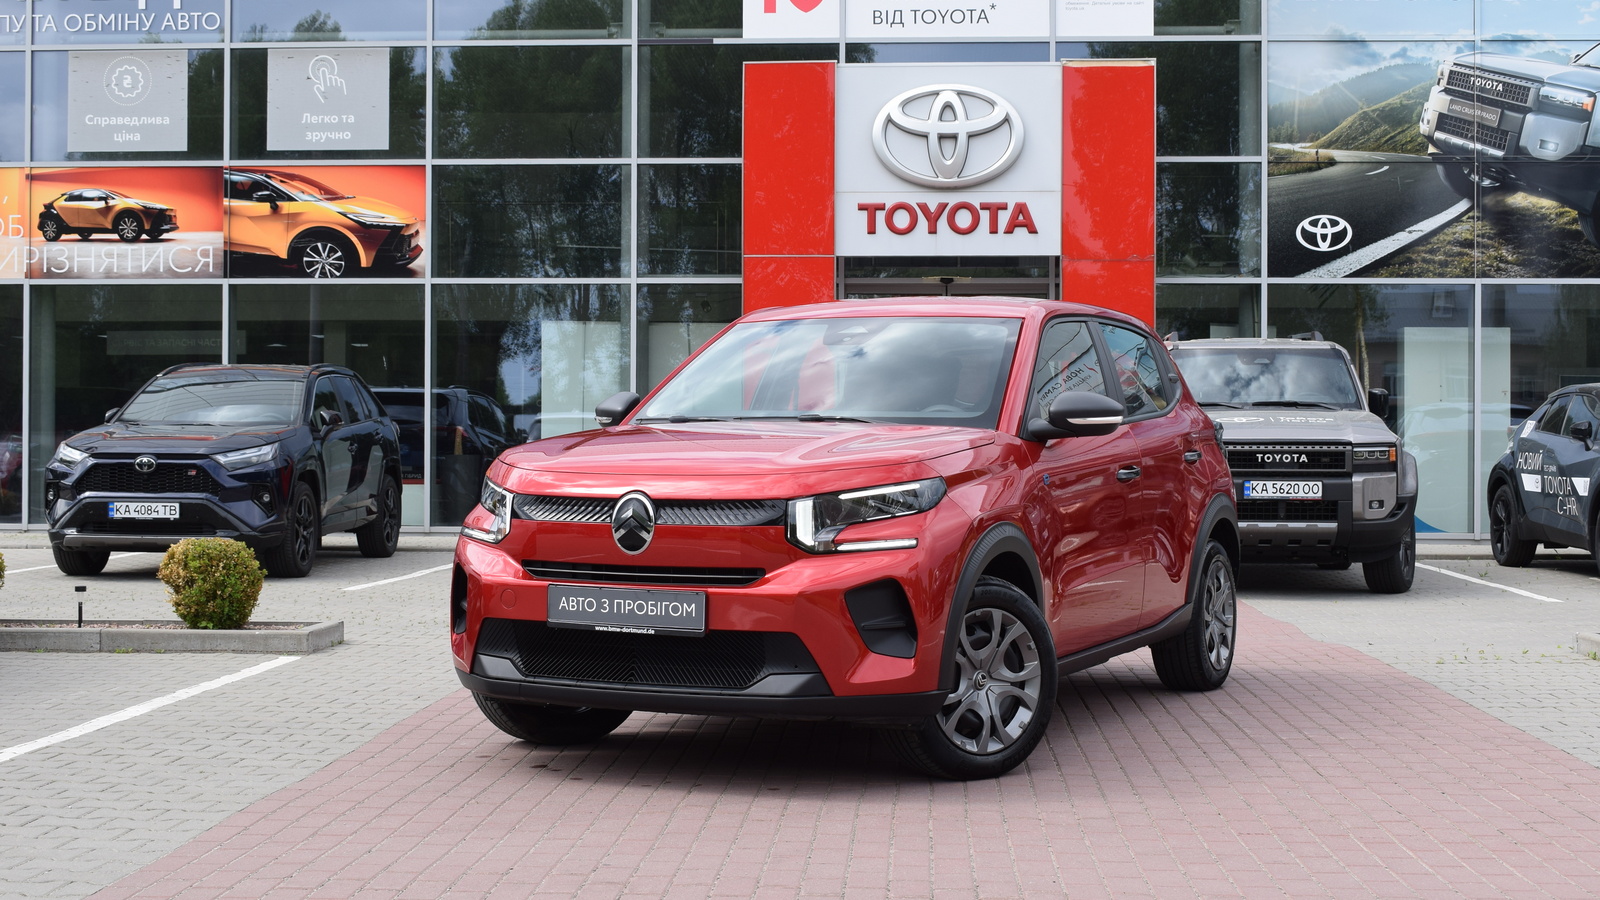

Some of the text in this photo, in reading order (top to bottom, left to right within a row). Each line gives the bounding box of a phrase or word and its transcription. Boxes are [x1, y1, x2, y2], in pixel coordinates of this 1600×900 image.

[32, 15, 57, 32] ТА
[64, 13, 156, 32] ОБМІНУ
[161, 12, 220, 31] АВТО
[872, 10, 905, 28] ВІД
[1470, 77, 1503, 92] TOYOTA
[301, 113, 355, 123] Легко та
[1449, 103, 1462, 112] LAND
[1481, 110, 1497, 121] PRADO
[85, 114, 170, 127] Справедлива
[114, 130, 141, 142] ціна
[305, 131, 351, 142] зручно
[857, 201, 1039, 236] TOYOTA
[1256, 454, 1308, 463] TOYOTA
[1516, 450, 1543, 471] НОВИЙ
[1251, 483, 1269, 494] KA
[1271, 483, 1300, 495] 5620
[1544, 476, 1573, 495] TOYOTA
[115, 504, 131, 515] KA
[134, 504, 159, 515] 4084
[161, 504, 177, 516] TB
[1557, 497, 1578, 516] C-HR
[558, 596, 597, 612] АВТО
[614, 600, 696, 617] ПРОБІГОМ
[595, 625, 655, 635] www.bmw-dortmund.de
